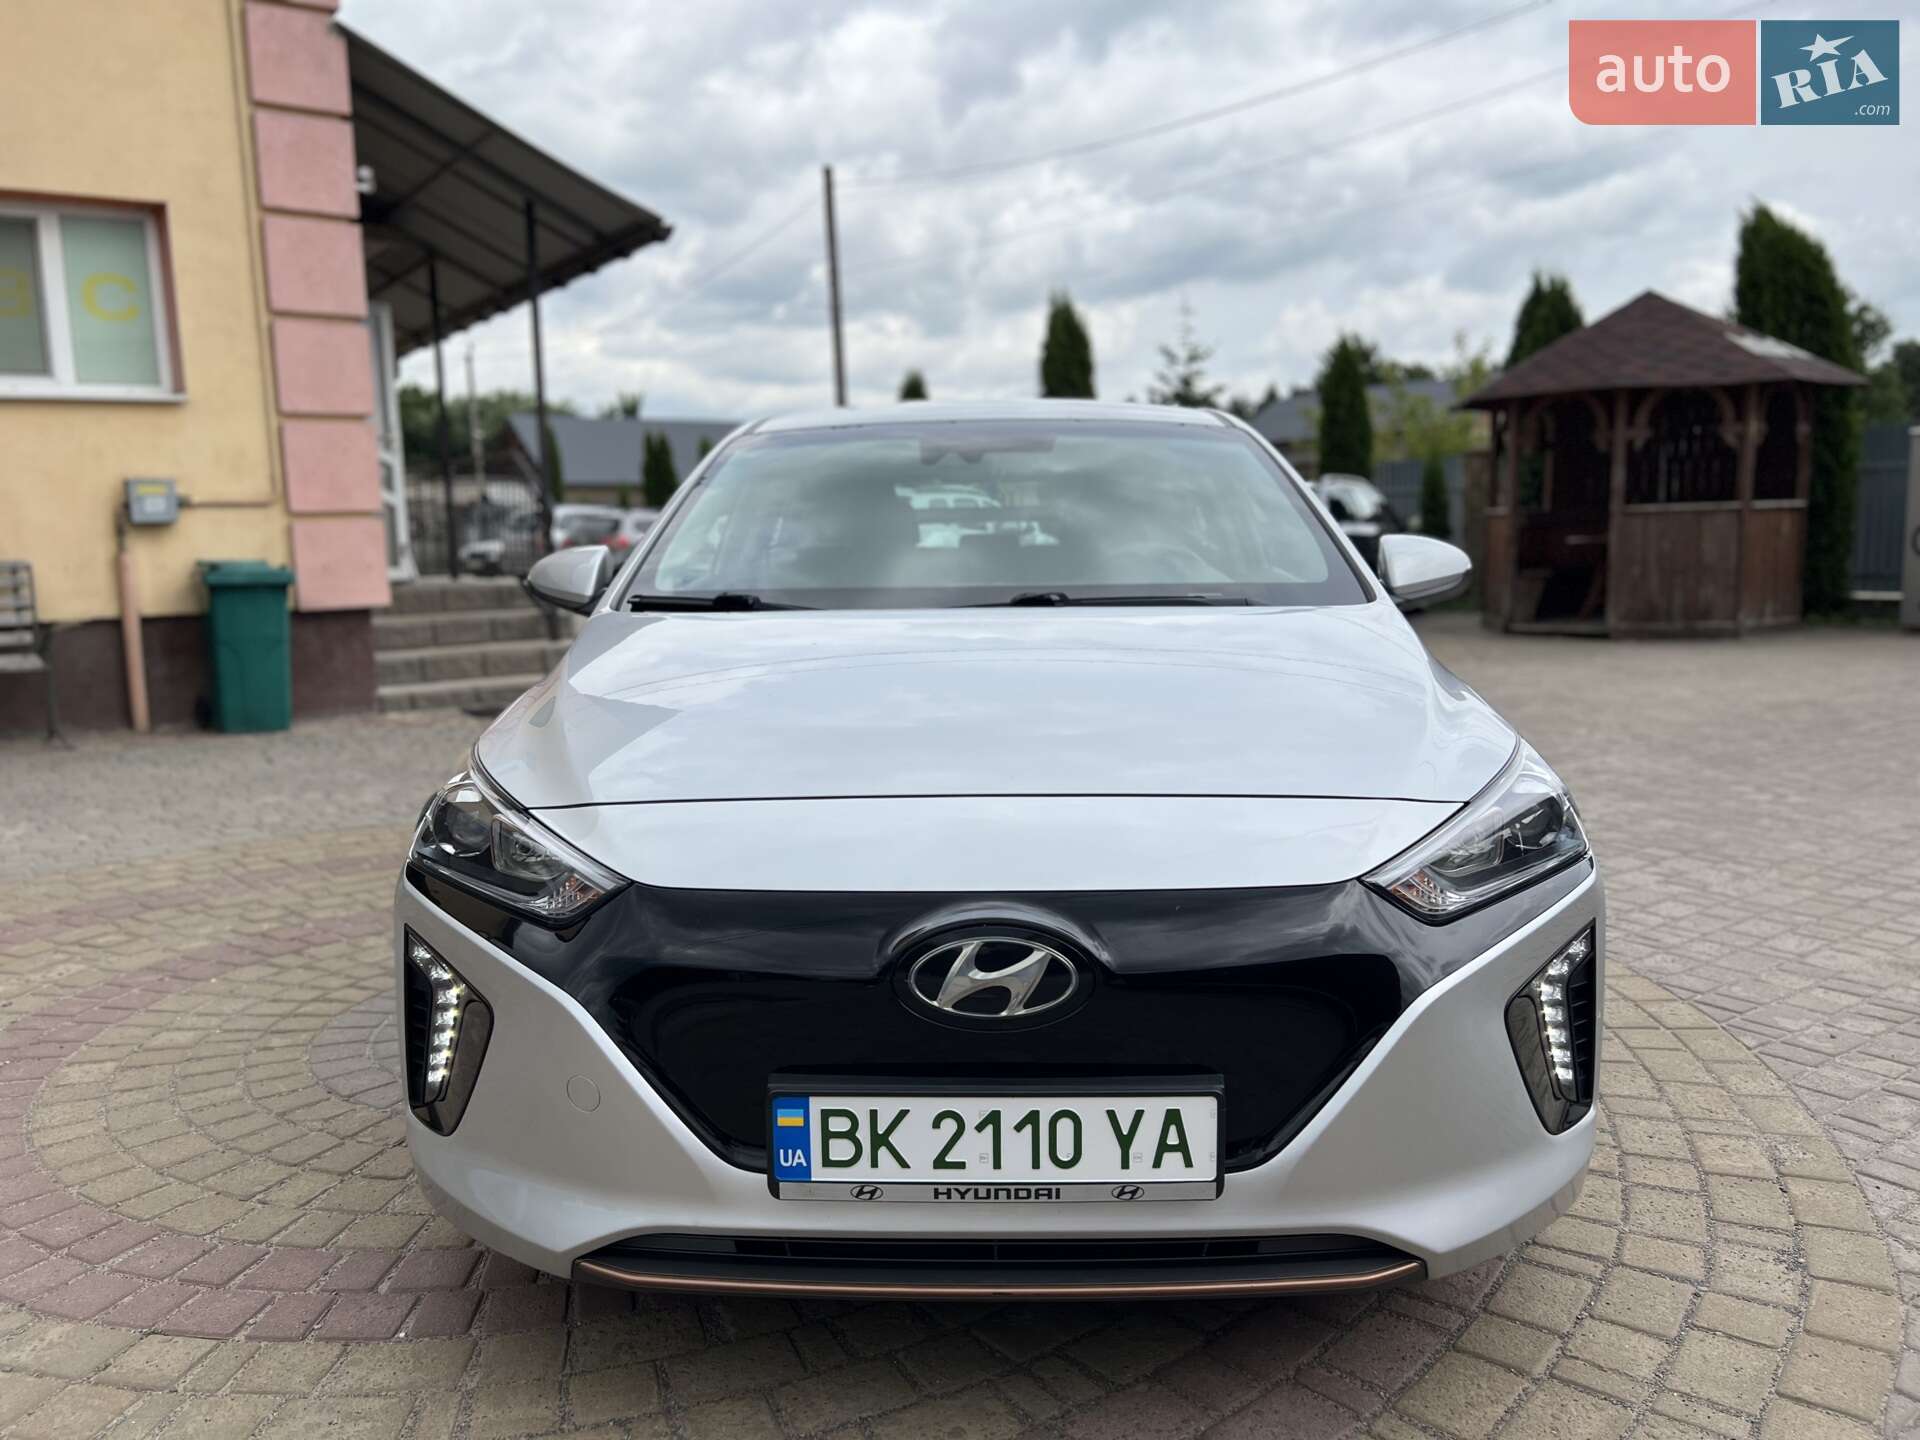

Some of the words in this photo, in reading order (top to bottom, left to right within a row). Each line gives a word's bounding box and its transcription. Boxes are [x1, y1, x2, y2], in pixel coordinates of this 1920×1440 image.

[820, 1109, 911, 1169] BK
[931, 1109, 1082, 1169] 2110
[1106, 1109, 1193, 1169] YA
[779, 1149, 807, 1167] UA
[933, 1187, 1060, 1200] HYUNDAI
